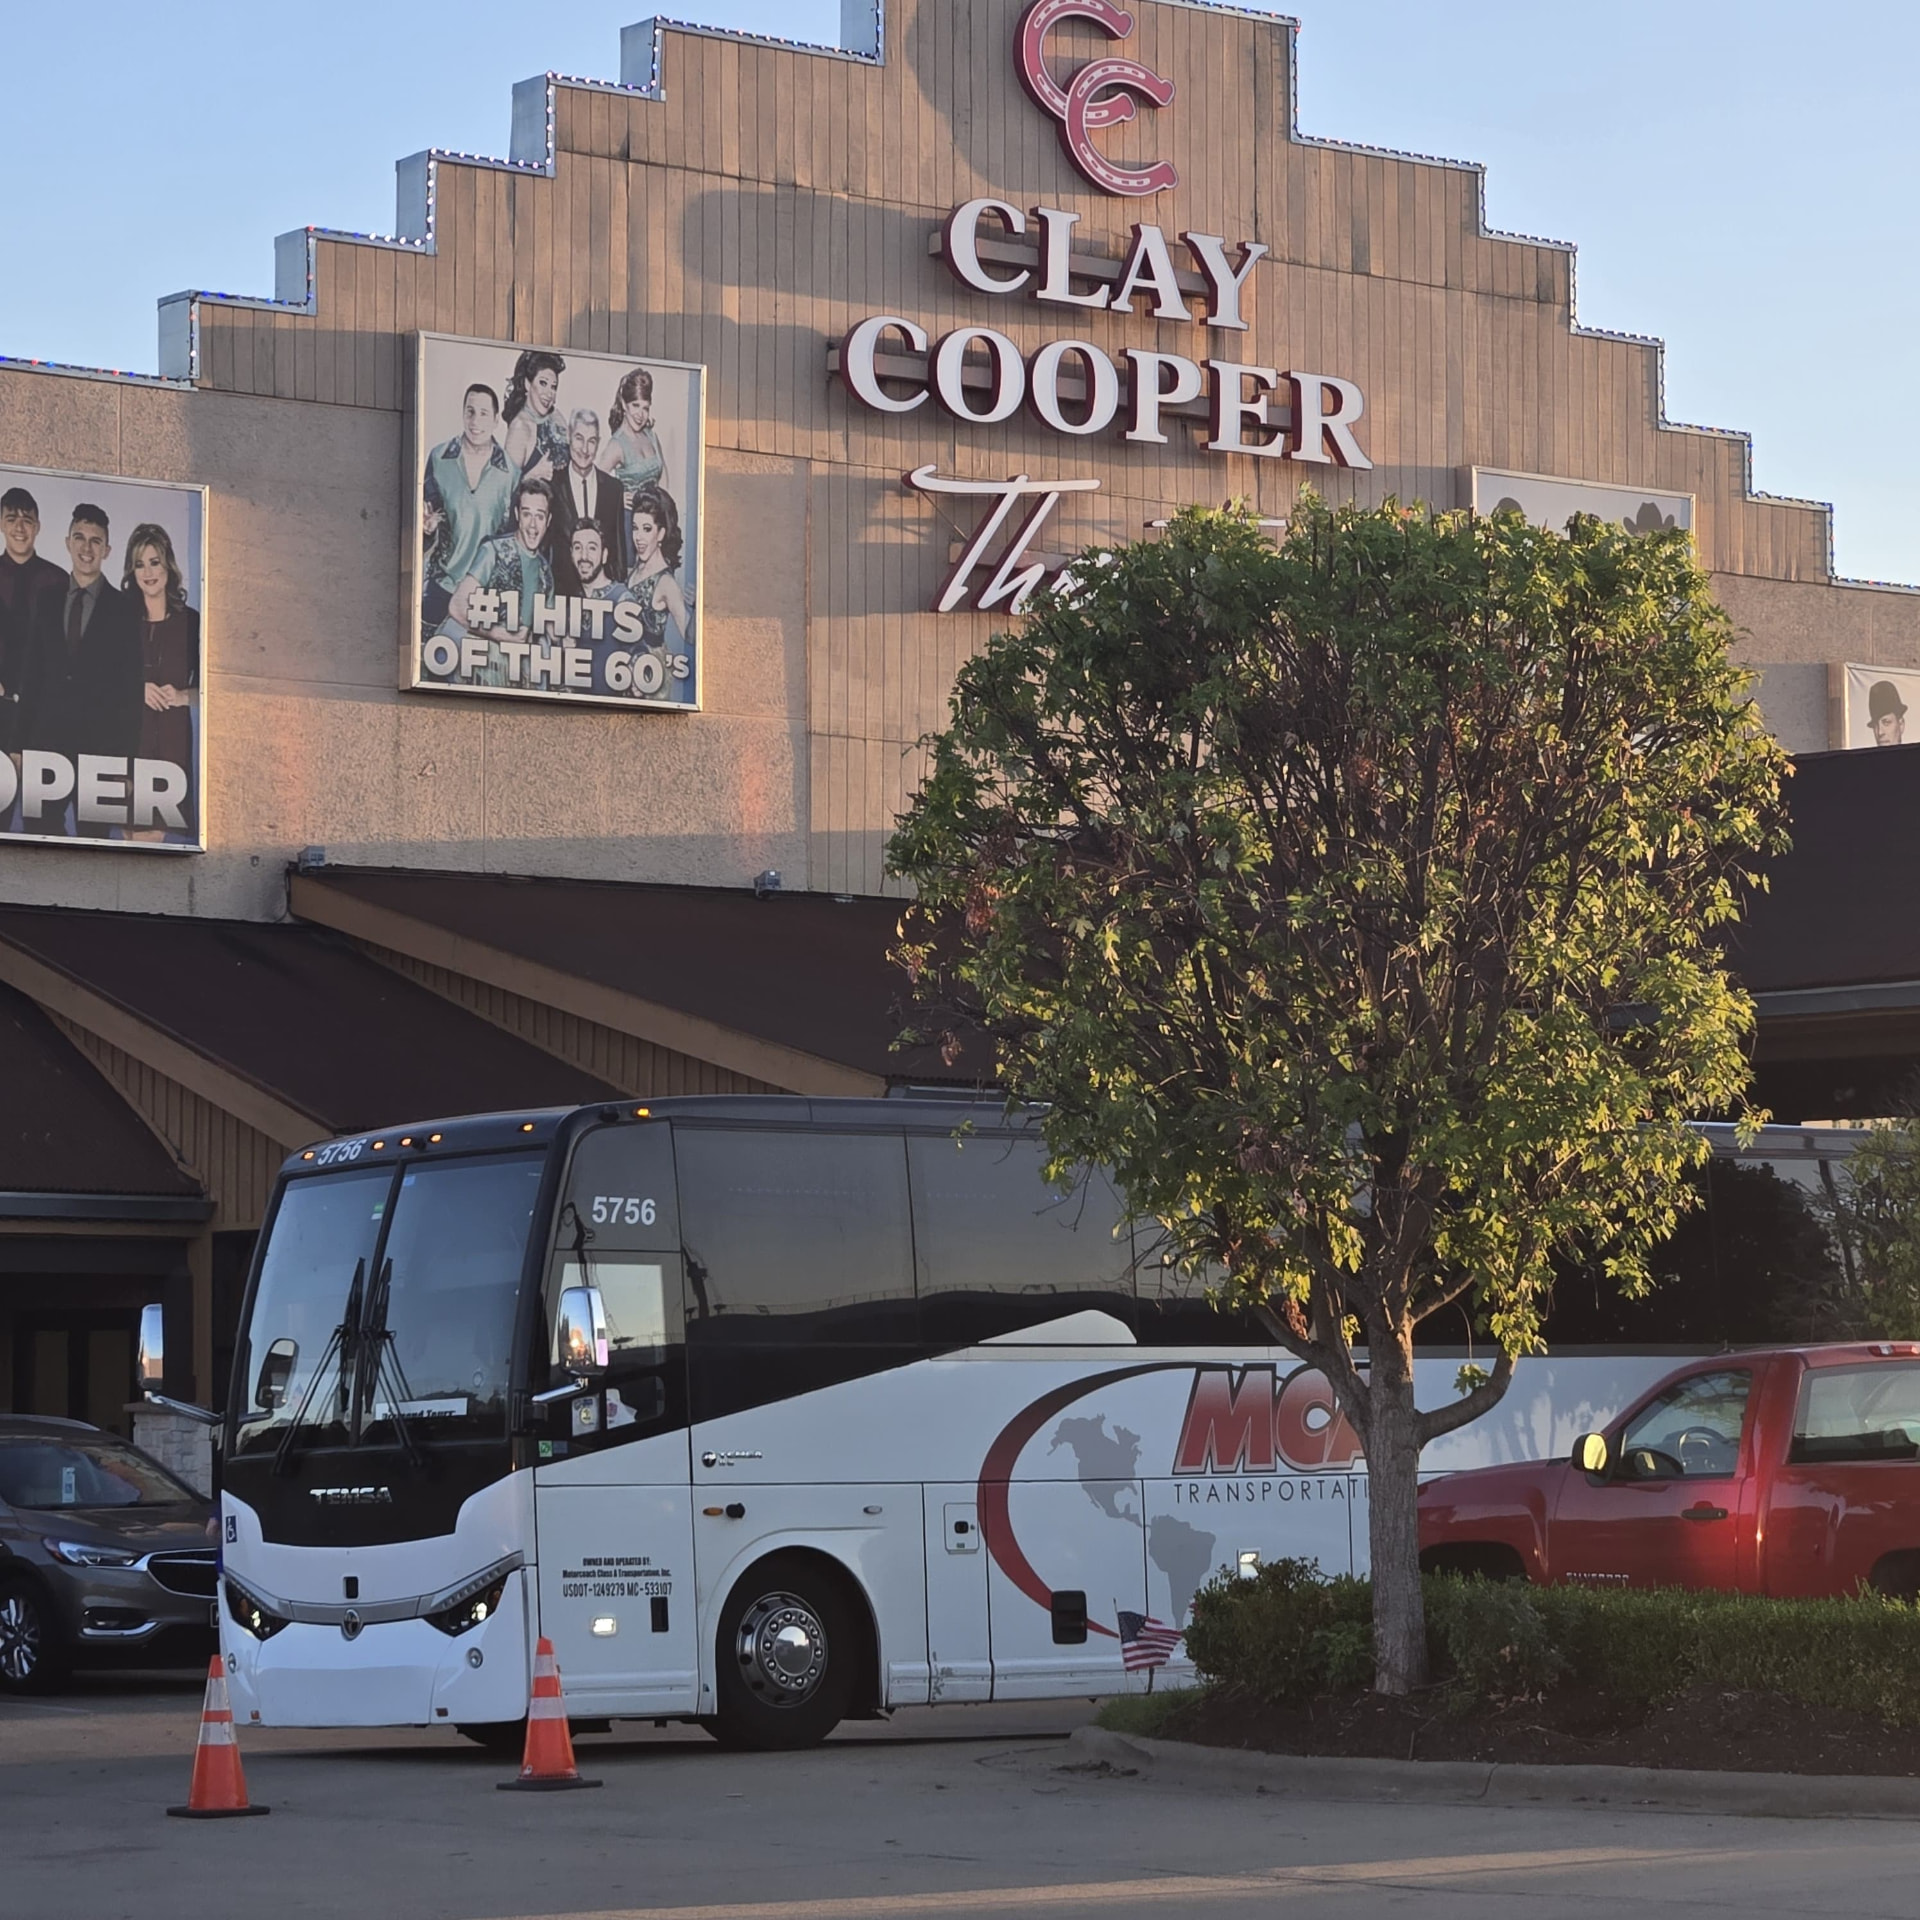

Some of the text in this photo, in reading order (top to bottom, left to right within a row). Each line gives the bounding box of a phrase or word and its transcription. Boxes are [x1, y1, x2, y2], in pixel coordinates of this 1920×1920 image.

[943, 198, 1268, 331] CLAY
[842, 315, 1373, 470] COOPER
[467, 587, 644, 643] #1 HITS
[423, 635, 489, 677] OF
[500, 641, 593, 688] THE
[0, 749, 188, 828] PER
[317, 1138, 367, 1166] 5756
[592, 1196, 656, 1225] 5756
[310, 1487, 392, 1504] TEMSA
[1174, 1479, 1367, 1504] TRANSPORTATI
[597, 1569, 612, 1577] Class
